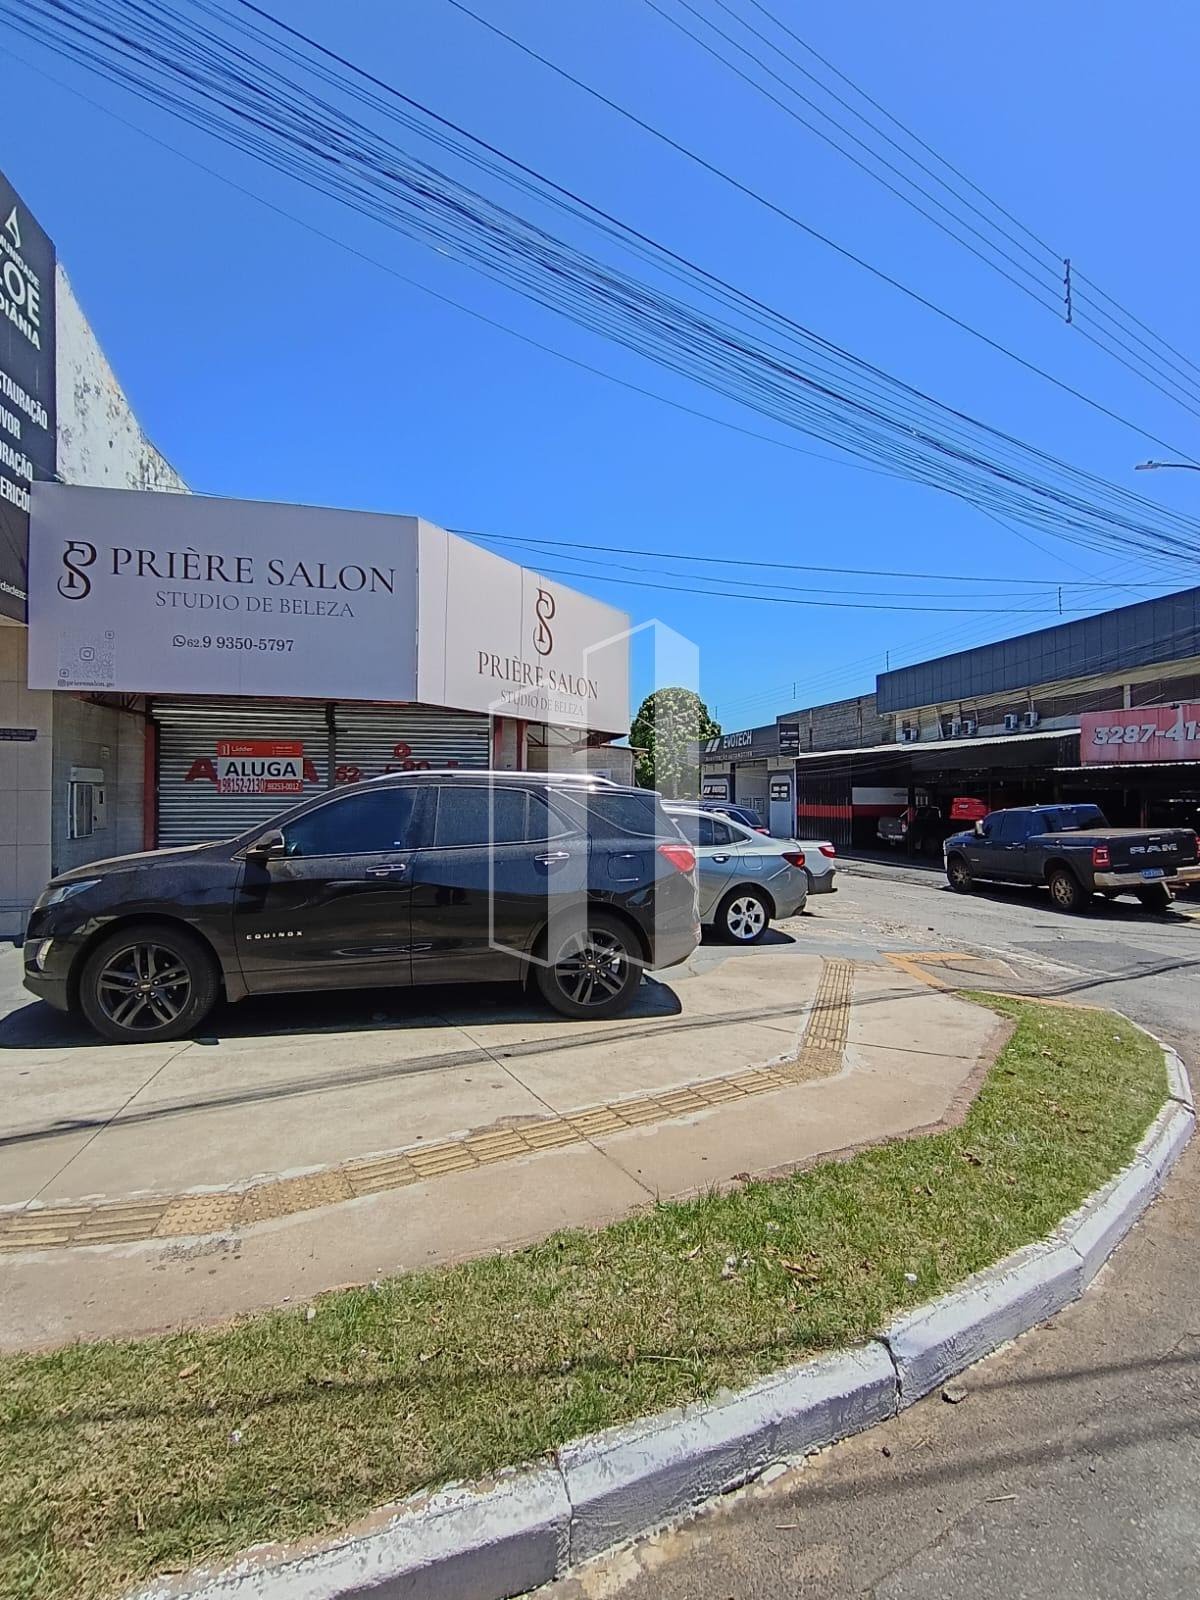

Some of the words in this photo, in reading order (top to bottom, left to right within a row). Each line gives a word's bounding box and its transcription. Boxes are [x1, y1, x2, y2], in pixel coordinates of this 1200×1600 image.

[0, 250, 40, 328] OE
[0, 370, 48, 430] TAURAÇÃO
[109, 546, 254, 584] PRIÈRE
[267, 558, 397, 594] SALON
[155, 591, 240, 611] STUDIO
[246, 596, 273, 612] DE
[279, 599, 355, 617] BELEZA
[216, 636, 294, 652] 9350-5797
[477, 650, 544, 689] PRIÈRE
[549, 669, 598, 700] SALON
[501, 689, 539, 710] STUDIO
[541, 697, 552, 711] DE
[554, 700, 585, 717] BELEZA
[225, 761, 297, 777] ALUGA
[1129, 843, 1178, 855] RAM
[246, 931, 302, 940] EQUINOX
